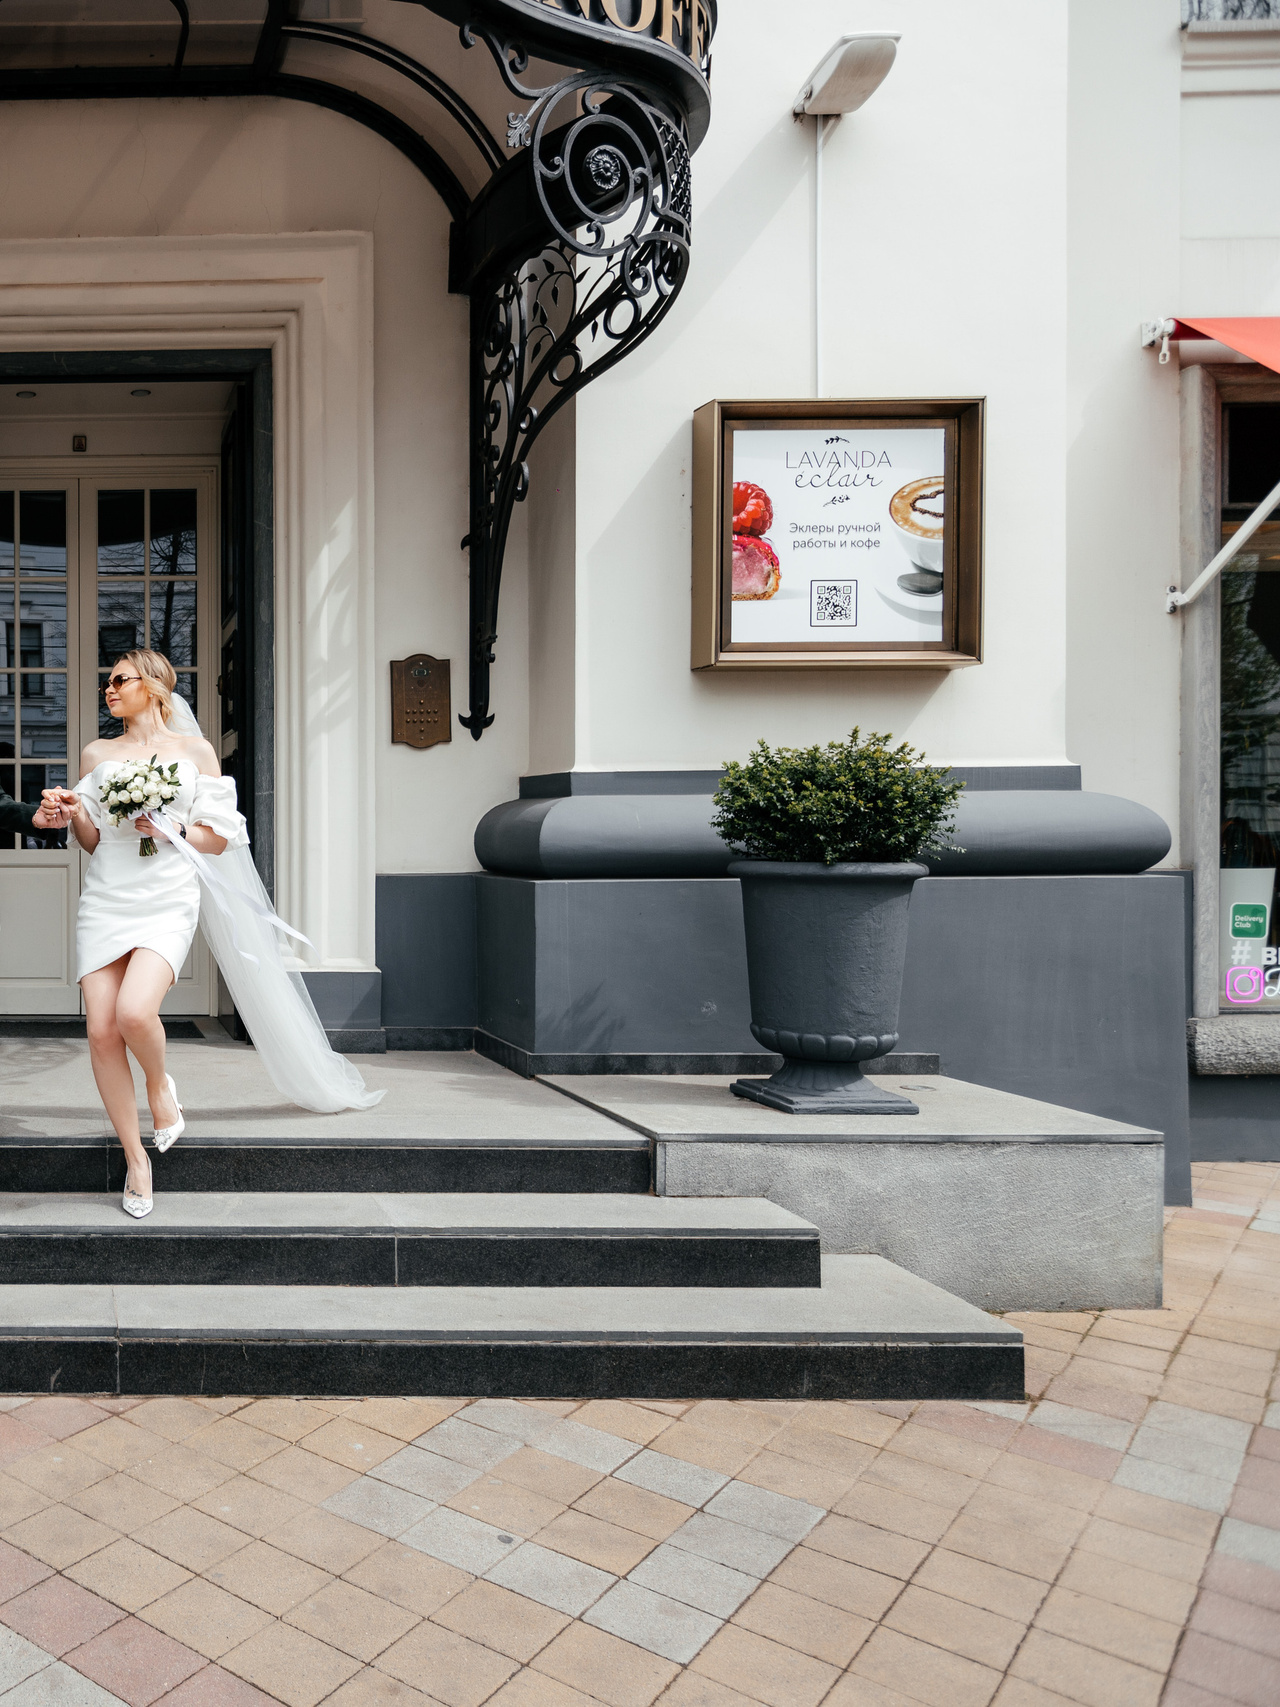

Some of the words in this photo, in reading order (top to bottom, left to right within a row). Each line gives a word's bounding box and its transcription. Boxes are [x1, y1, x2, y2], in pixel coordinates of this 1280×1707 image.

[785, 450, 892, 469] LAVANDA
[789, 522, 834, 535] Эклеры
[837, 522, 881, 535] ручной
[793, 538, 836, 550] работы
[840, 540, 847, 548] и
[851, 538, 880, 550] кофе
[1234, 915, 1264, 923] Delivery
